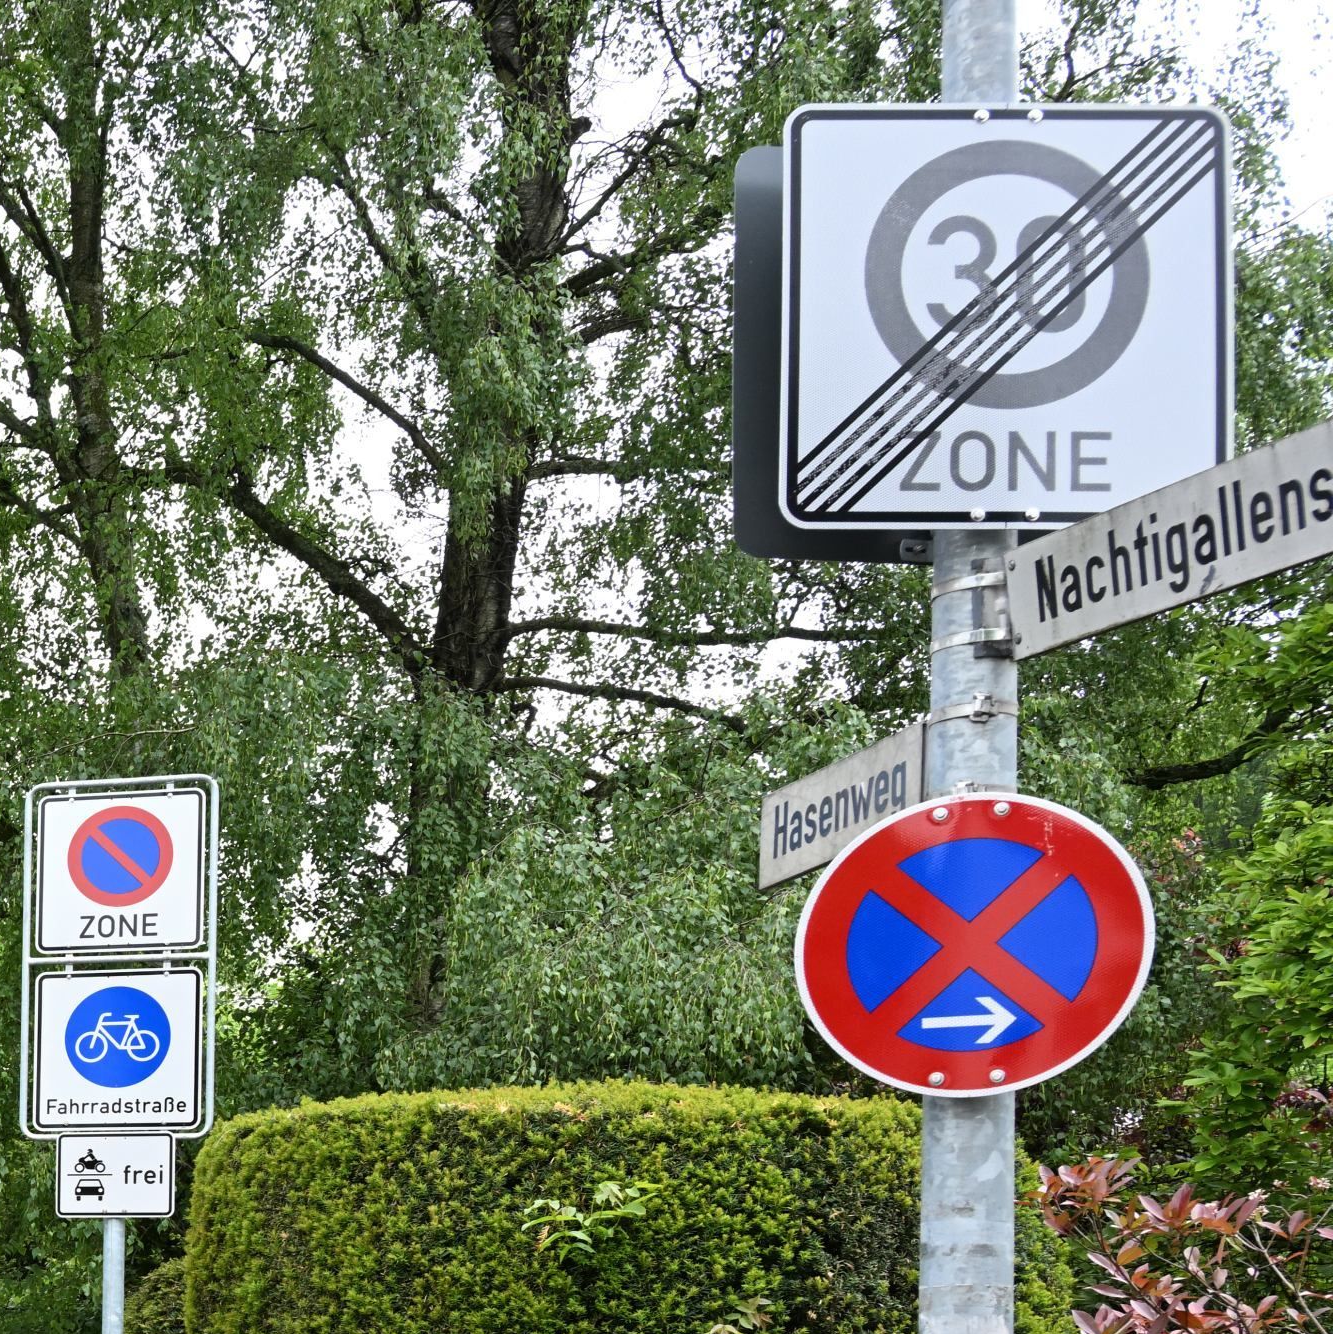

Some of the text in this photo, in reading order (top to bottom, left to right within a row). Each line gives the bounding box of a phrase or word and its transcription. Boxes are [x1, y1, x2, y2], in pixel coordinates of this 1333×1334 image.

[925, 214, 1088, 334] 30
[898, 430, 1113, 493] ZONE
[1034, 467, 1333, 624] Nachtigallens
[772, 760, 908, 860] Hasenweg
[78, 912, 160, 940] ZONE
[45, 1095, 188, 1117] Fahrradstraße
[122, 1163, 165, 1186] frei
